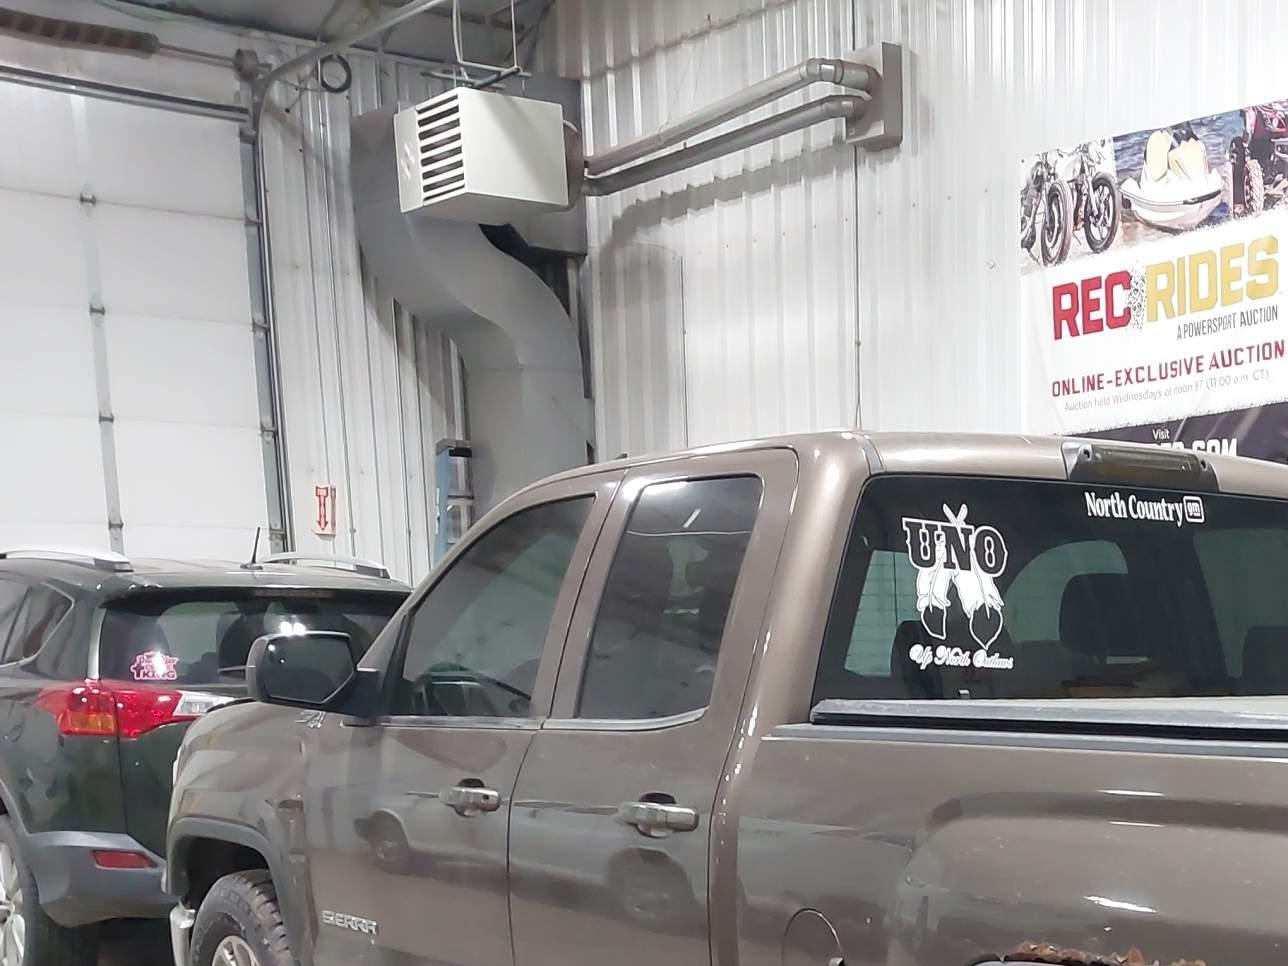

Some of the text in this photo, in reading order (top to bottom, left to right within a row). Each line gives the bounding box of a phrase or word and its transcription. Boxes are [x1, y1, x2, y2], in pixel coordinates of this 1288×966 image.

[1052, 235, 1279, 341] REC RIDES
[1183, 312, 1236, 340] POWERSPORT
[1240, 304, 1278, 328] AUCTION
[1052, 339, 1285, 397] ONLINE-EXCLUSIVE AUCTION
[1152, 428, 1170, 441] Visit
[1084, 491, 1128, 519] North
[1128, 494, 1183, 528] Country
[902, 517, 1008, 577] UNO
